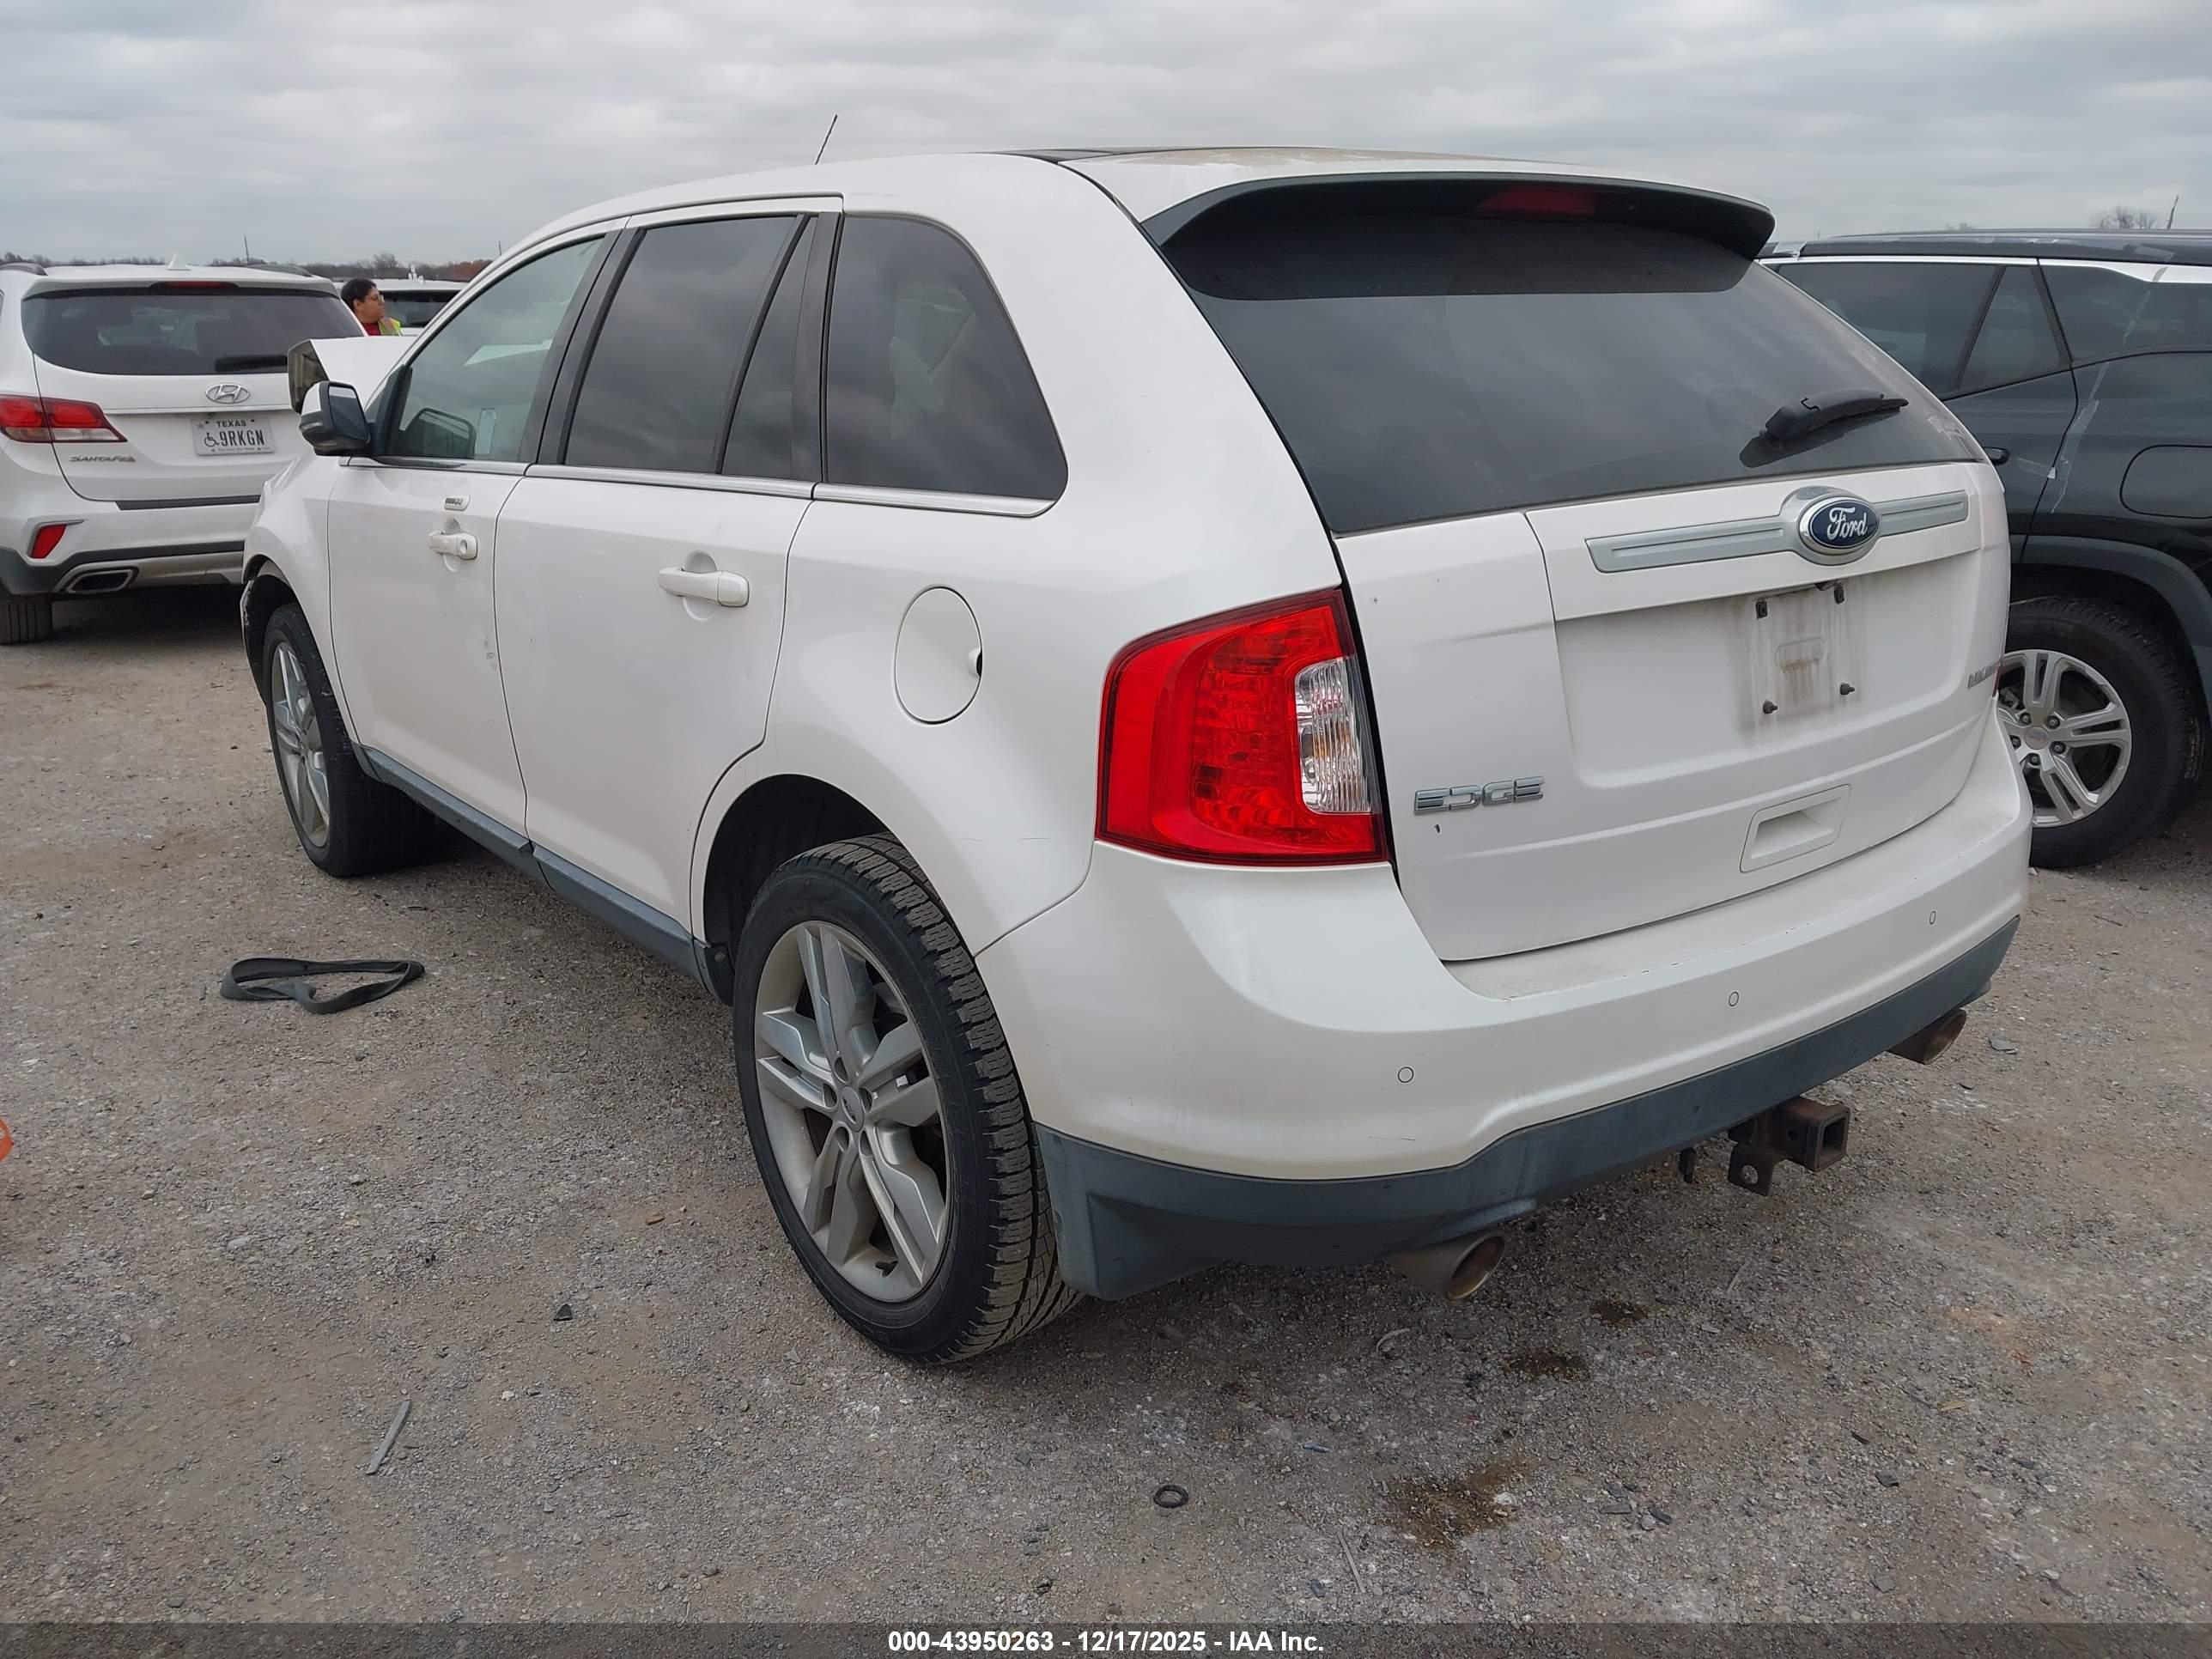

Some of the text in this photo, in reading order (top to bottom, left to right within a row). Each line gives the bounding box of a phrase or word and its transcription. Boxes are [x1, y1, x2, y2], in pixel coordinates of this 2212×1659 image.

[216, 419, 246, 428] TEXAS
[219, 429, 264, 447] 9RKGN
[1826, 507, 1868, 540] Ford
[1413, 775, 1545, 816] EDGE
